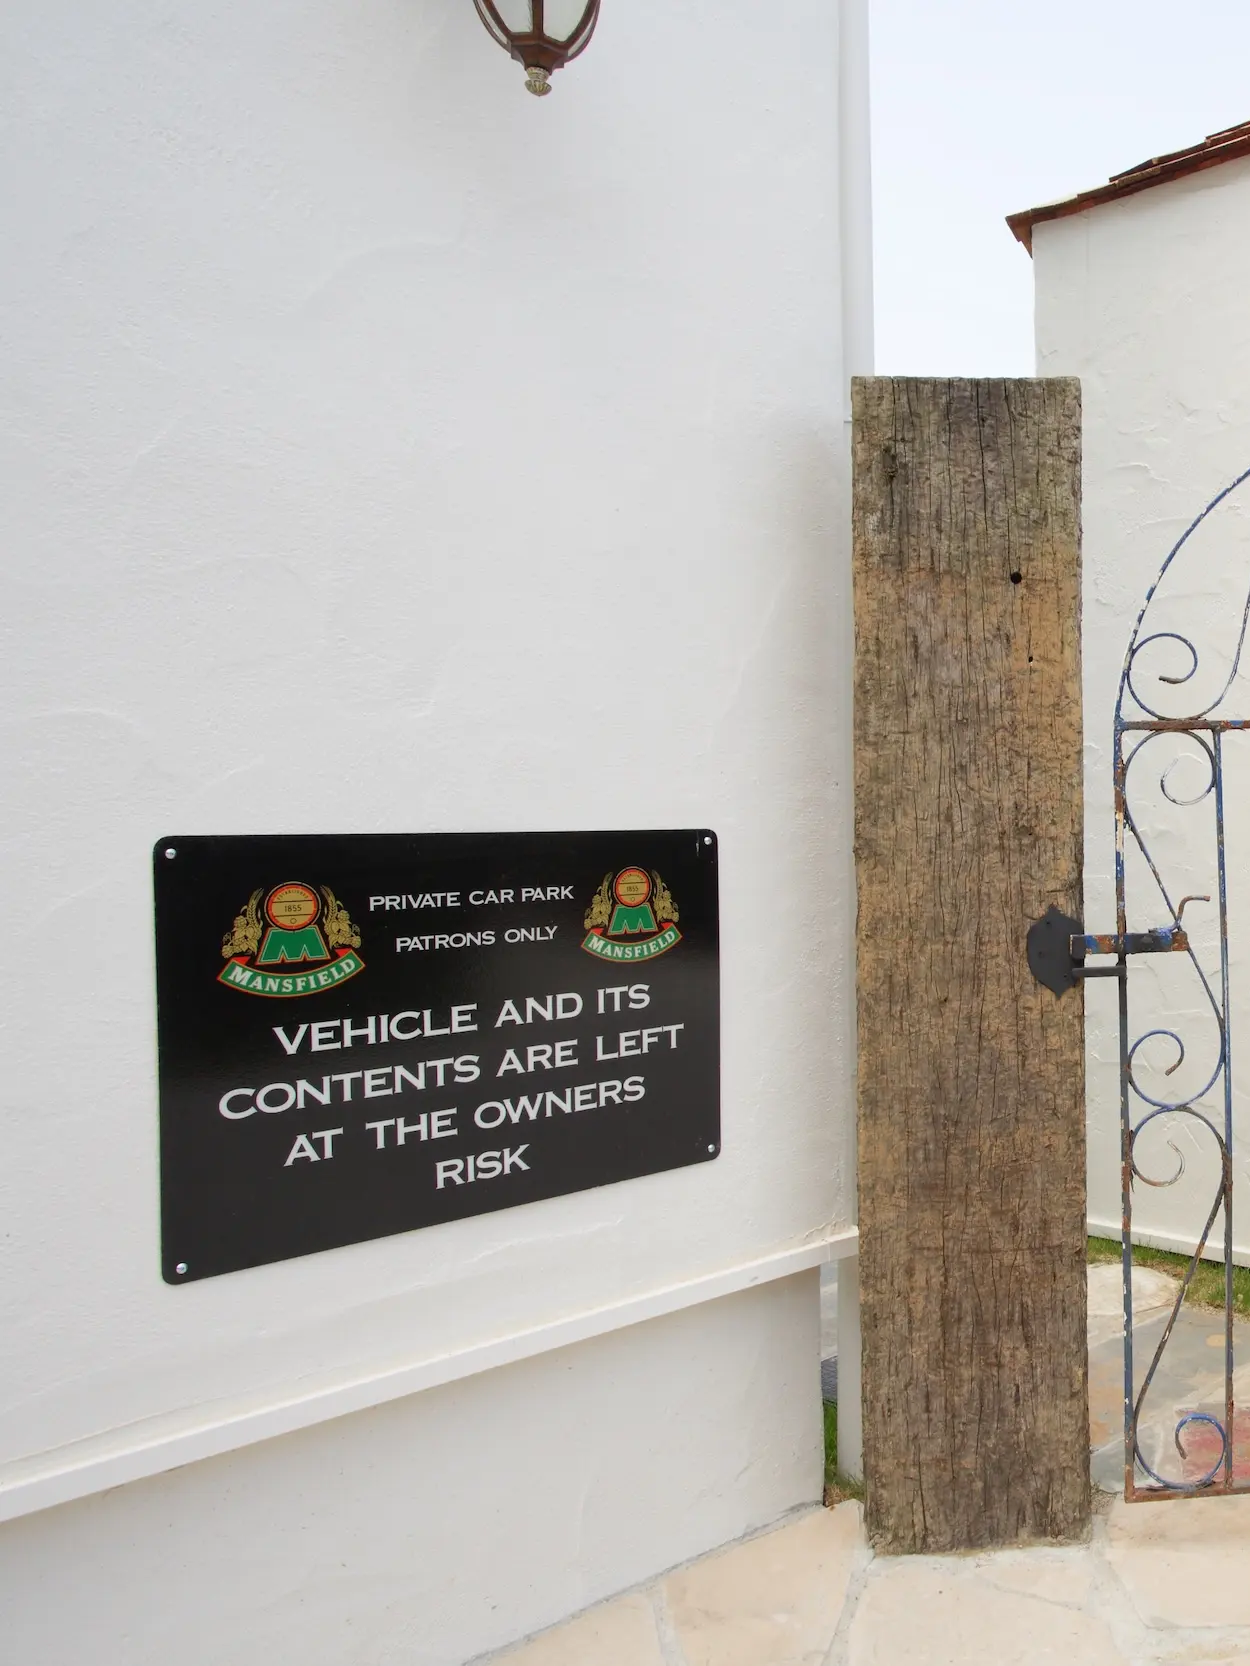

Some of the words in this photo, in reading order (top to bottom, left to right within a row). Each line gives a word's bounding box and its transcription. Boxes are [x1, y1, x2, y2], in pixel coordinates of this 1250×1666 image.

[284, 904, 302, 913] 1855
[369, 891, 461, 912] PRIVATE
[468, 889, 515, 906] CAR
[521, 885, 574, 902] PARK
[396, 930, 496, 953] PATRONS
[504, 925, 558, 943] ONLY
[588, 931, 676, 959] MANSFIELD
[227, 958, 356, 993] MANSFIELD
[272, 1003, 478, 1056] VEHICLE
[494, 992, 584, 1029] AND
[596, 983, 652, 1014] ITS
[218, 1054, 481, 1121] CONTENTS
[495, 1038, 579, 1078] ARE
[594, 1022, 685, 1062] LEFT
[283, 1126, 344, 1168] AT
[364, 1107, 458, 1151] THE
[473, 1075, 646, 1130] OWNERS
[435, 1143, 531, 1190] RISK
